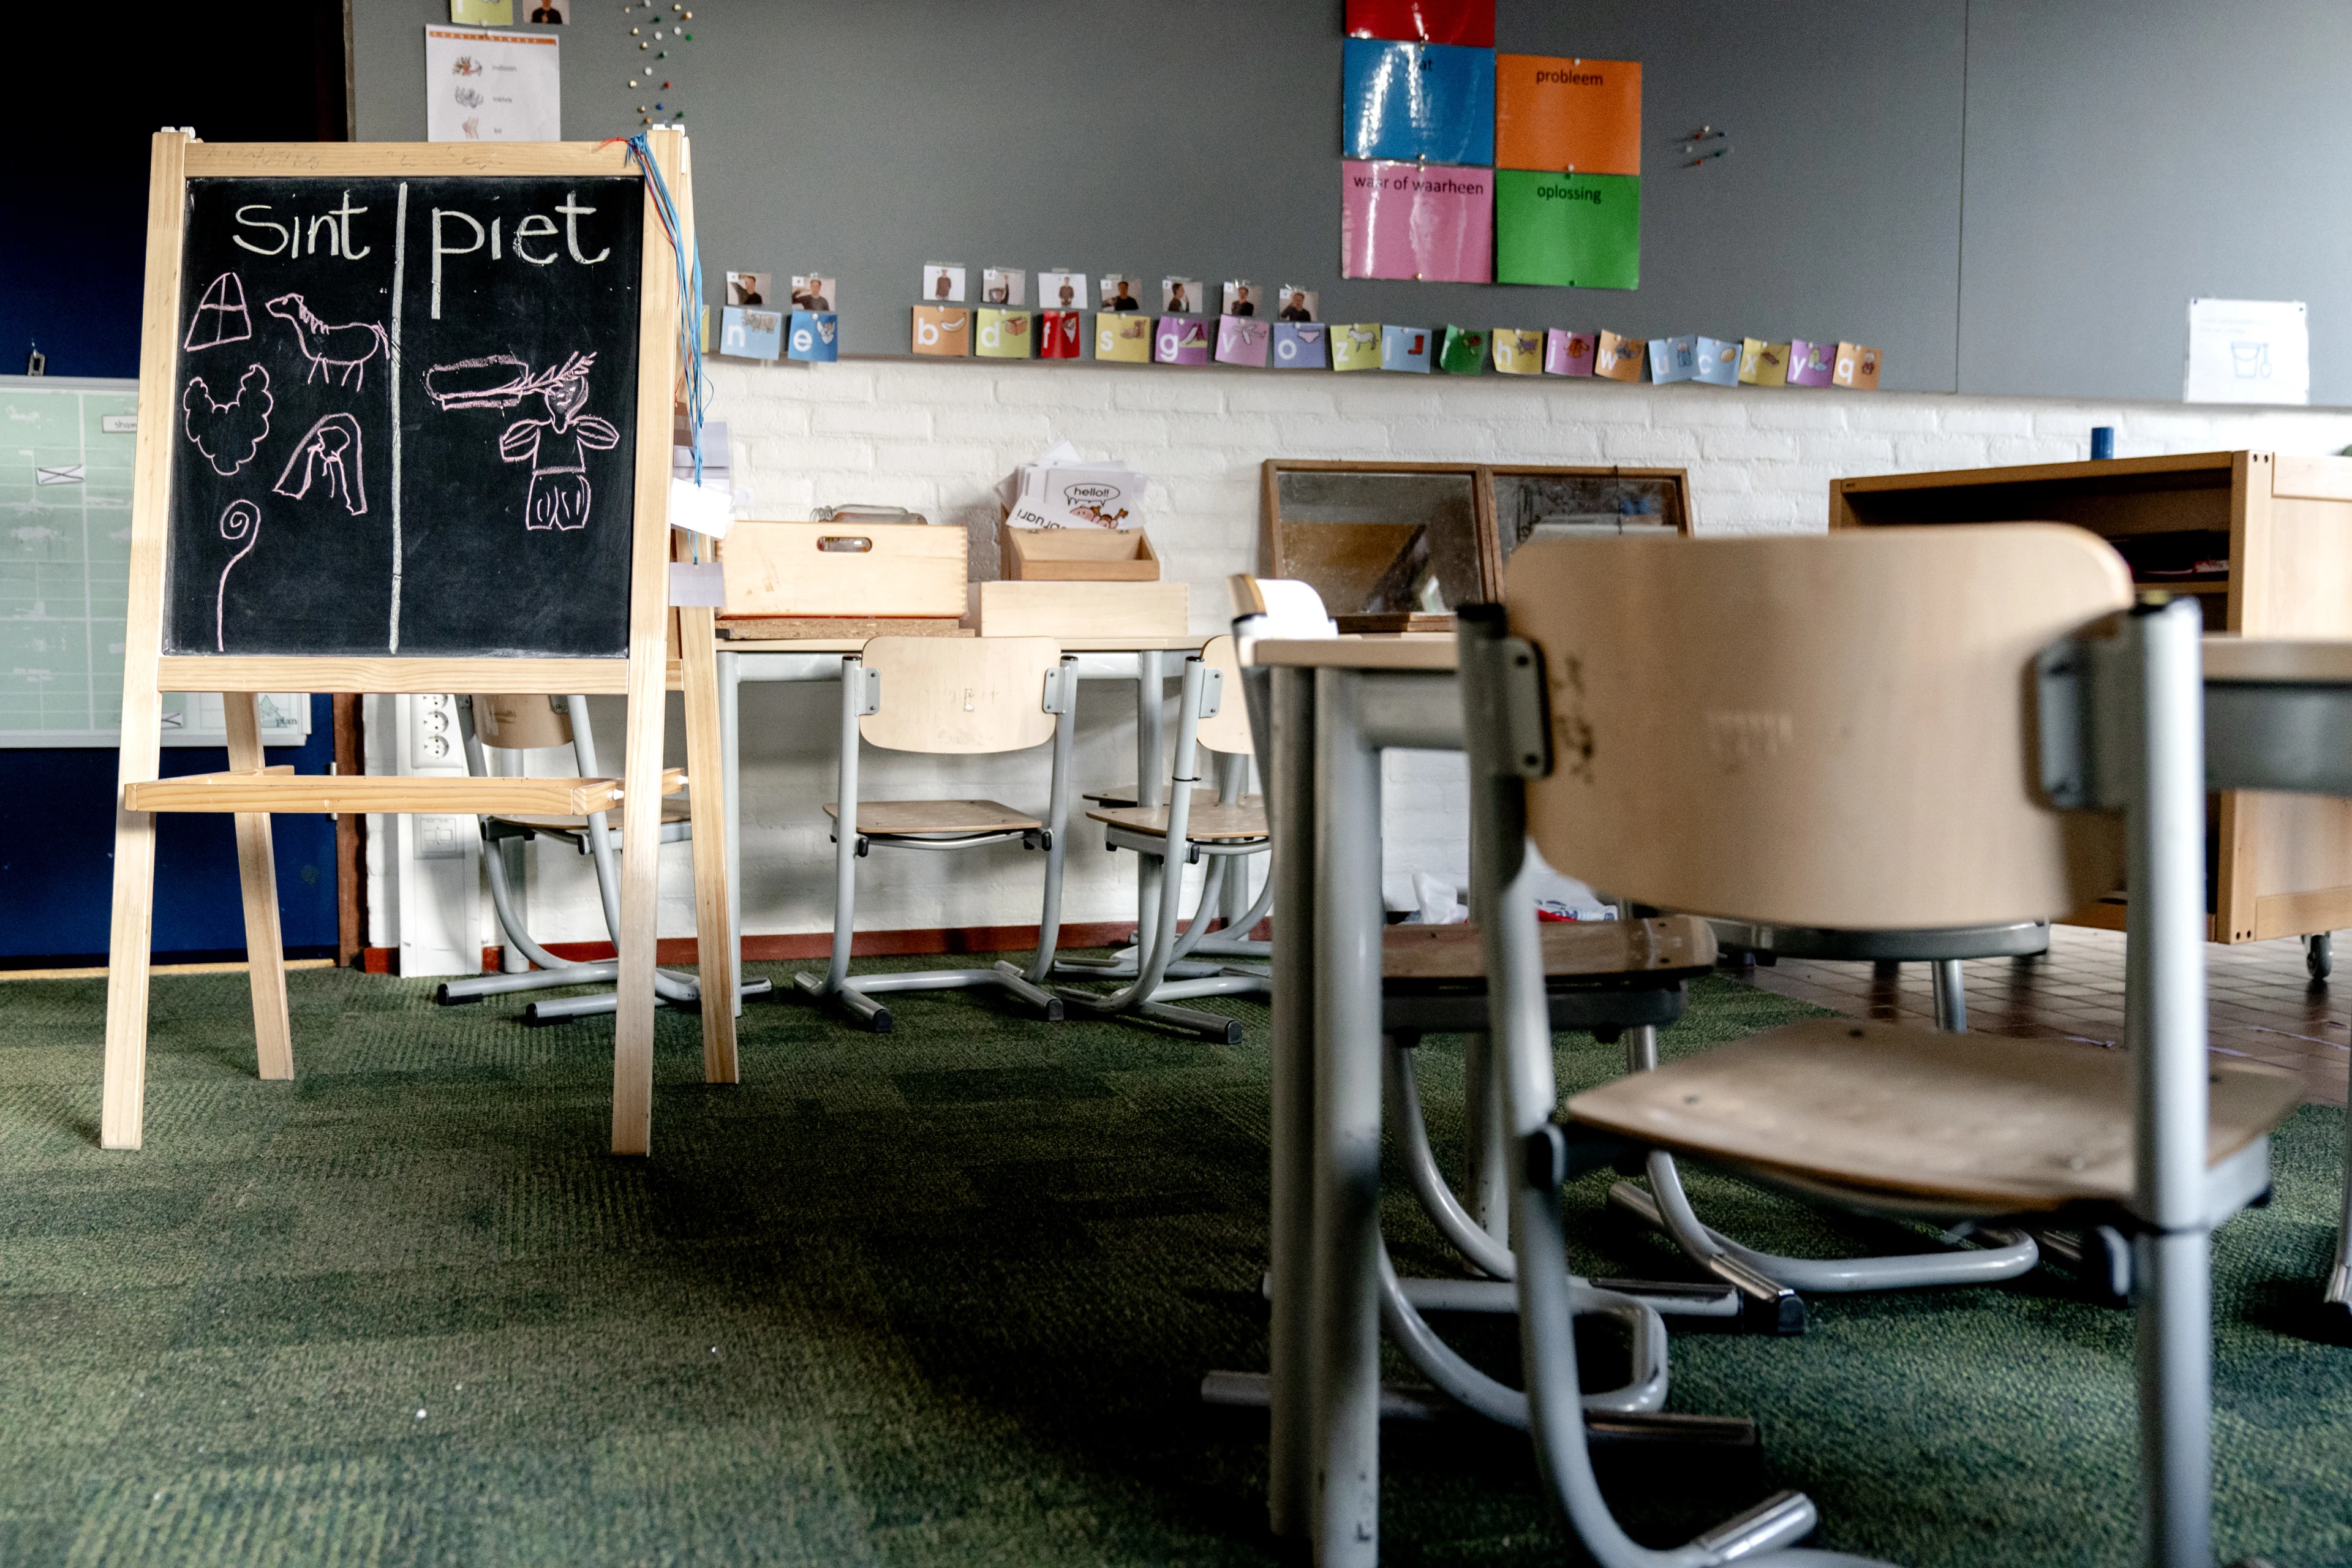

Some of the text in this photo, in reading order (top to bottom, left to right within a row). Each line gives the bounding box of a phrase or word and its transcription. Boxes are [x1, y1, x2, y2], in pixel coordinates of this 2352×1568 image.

[1536, 69, 1603, 86] probleem
[1394, 176, 1408, 190] of
[1412, 179, 1483, 195] waarheen
[1537, 184, 1601, 204] oplossing
[232, 190, 371, 260] Sint
[432, 191, 611, 320] piet
[727, 325, 745, 347] n
[793, 330, 813, 352] e
[918, 317, 939, 345] b
[981, 322, 1000, 348] d
[1043, 322, 1050, 349] f
[1099, 331, 1114, 351] s
[1159, 334, 1178, 361] g
[1222, 333, 1237, 353] v
[1278, 339, 1297, 360] o
[1336, 342, 1349, 361] z
[1496, 340, 1512, 366] h
[1548, 339, 1556, 370] j
[1601, 349, 1618, 371] w
[1698, 354, 1713, 375] c
[1743, 353, 1758, 375] x
[1656, 357, 1670, 376] u
[1792, 355, 1807, 380] y
[1838, 358, 1855, 383] q
[1014, 509, 1066, 529] bruari
[276, 717, 298, 728] plan
